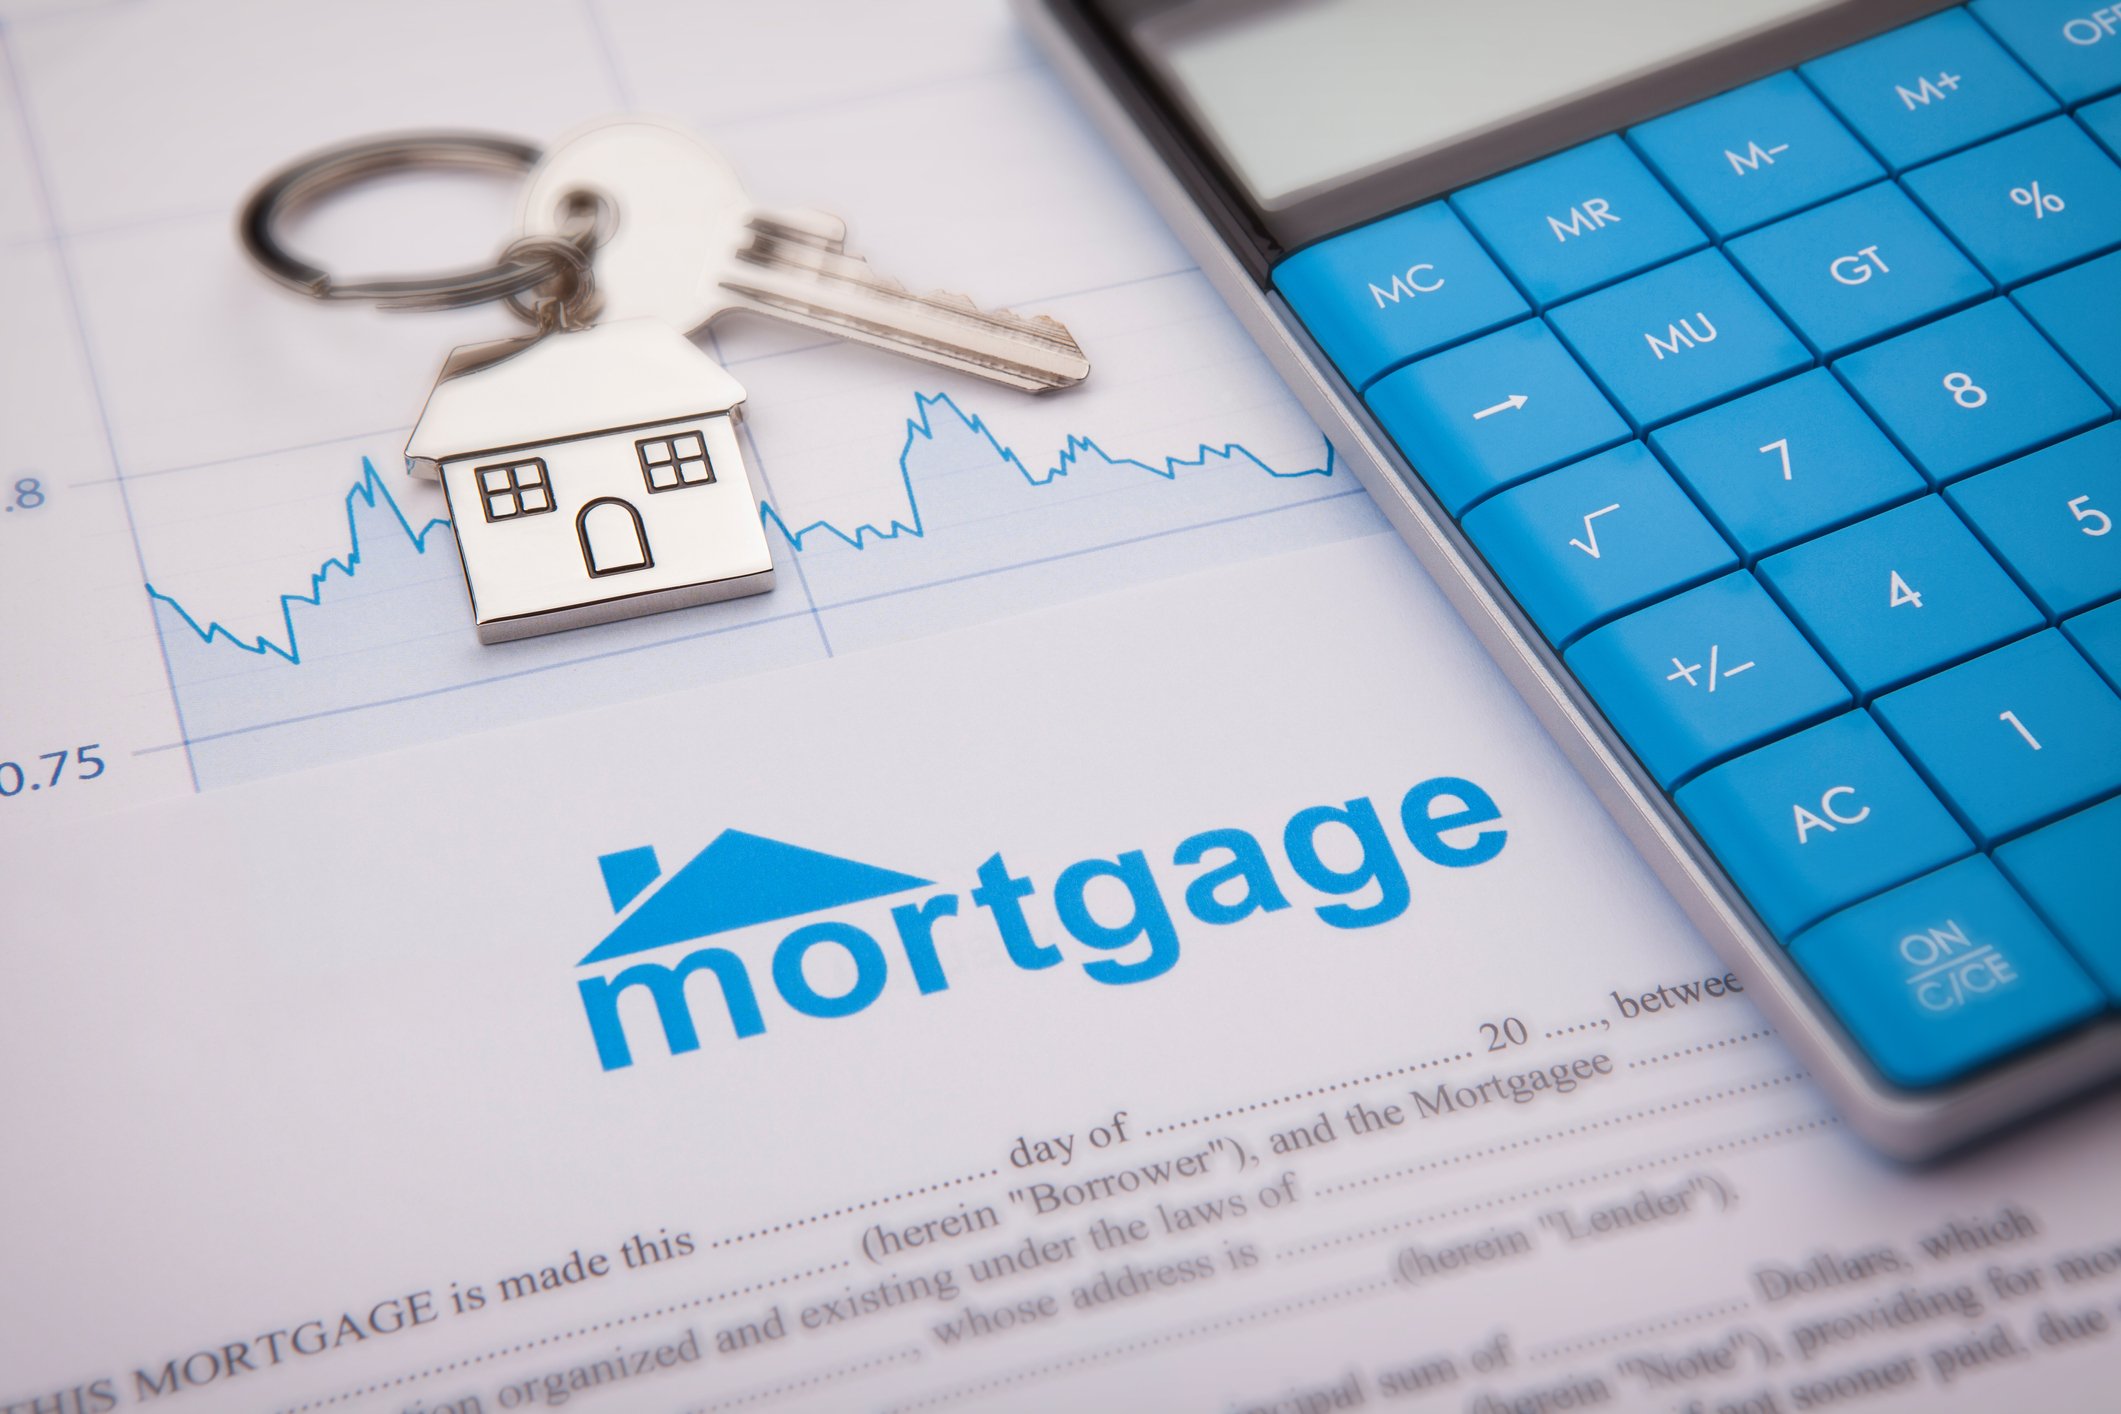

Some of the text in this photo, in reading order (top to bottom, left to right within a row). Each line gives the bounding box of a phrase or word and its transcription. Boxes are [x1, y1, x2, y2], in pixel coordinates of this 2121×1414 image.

[1895, 69, 1962, 111] M+
[1547, 198, 1620, 243] MR
[2010, 181, 2065, 219] %
[1368, 263, 1445, 309] MC
[1829, 245, 1890, 286] GT
[1644, 311, 1718, 360] MU
[1942, 371, 1988, 409] 8
[1760, 439, 1794, 480] 7
[2067, 495, 2112, 536] 5
[1890, 570, 1923, 609] 4
[1999, 710, 2042, 750] 1
[0, 744, 105, 797] 0.75
[1792, 786, 1870, 844] AC
[577, 776, 1508, 1073] mortgage
[1900, 918, 1971, 966] ON
[1915, 952, 2019, 1014] C/CE
[861, 1048, 1613, 1265] (herein "Borrower"), and the Mortgagee
[132, 1289, 438, 1402] MORTGAGE
[449, 1283, 486, 1315] is
[497, 1250, 610, 1302] made
[620, 1228, 695, 1270] this
[1010, 1132, 1075, 1169] day
[1088, 1111, 1130, 1150] of
[1479, 1016, 1530, 1053] 20
[1396, 1222, 1532, 1287] (herein
[498, 1328, 702, 1408] organized
[715, 1307, 787, 1356] and
[800, 1262, 960, 1332] existing
[969, 1230, 1077, 1285] under
[1088, 1213, 1150, 1252] the
[1163, 1187, 1248, 1236] laws
[1257, 1171, 1300, 1210] of
[933, 1237, 1259, 1350] whose address is
[1377, 1357, 1460, 1398] sum
[1470, 1331, 1513, 1373] of
[1918, 1208, 2038, 1260] which
[1790, 1281, 1985, 1354] providing
[1986, 1265, 2042, 1300] for
[1790, 1356, 1917, 1408] sooner
[2037, 1310, 2109, 1345] due
